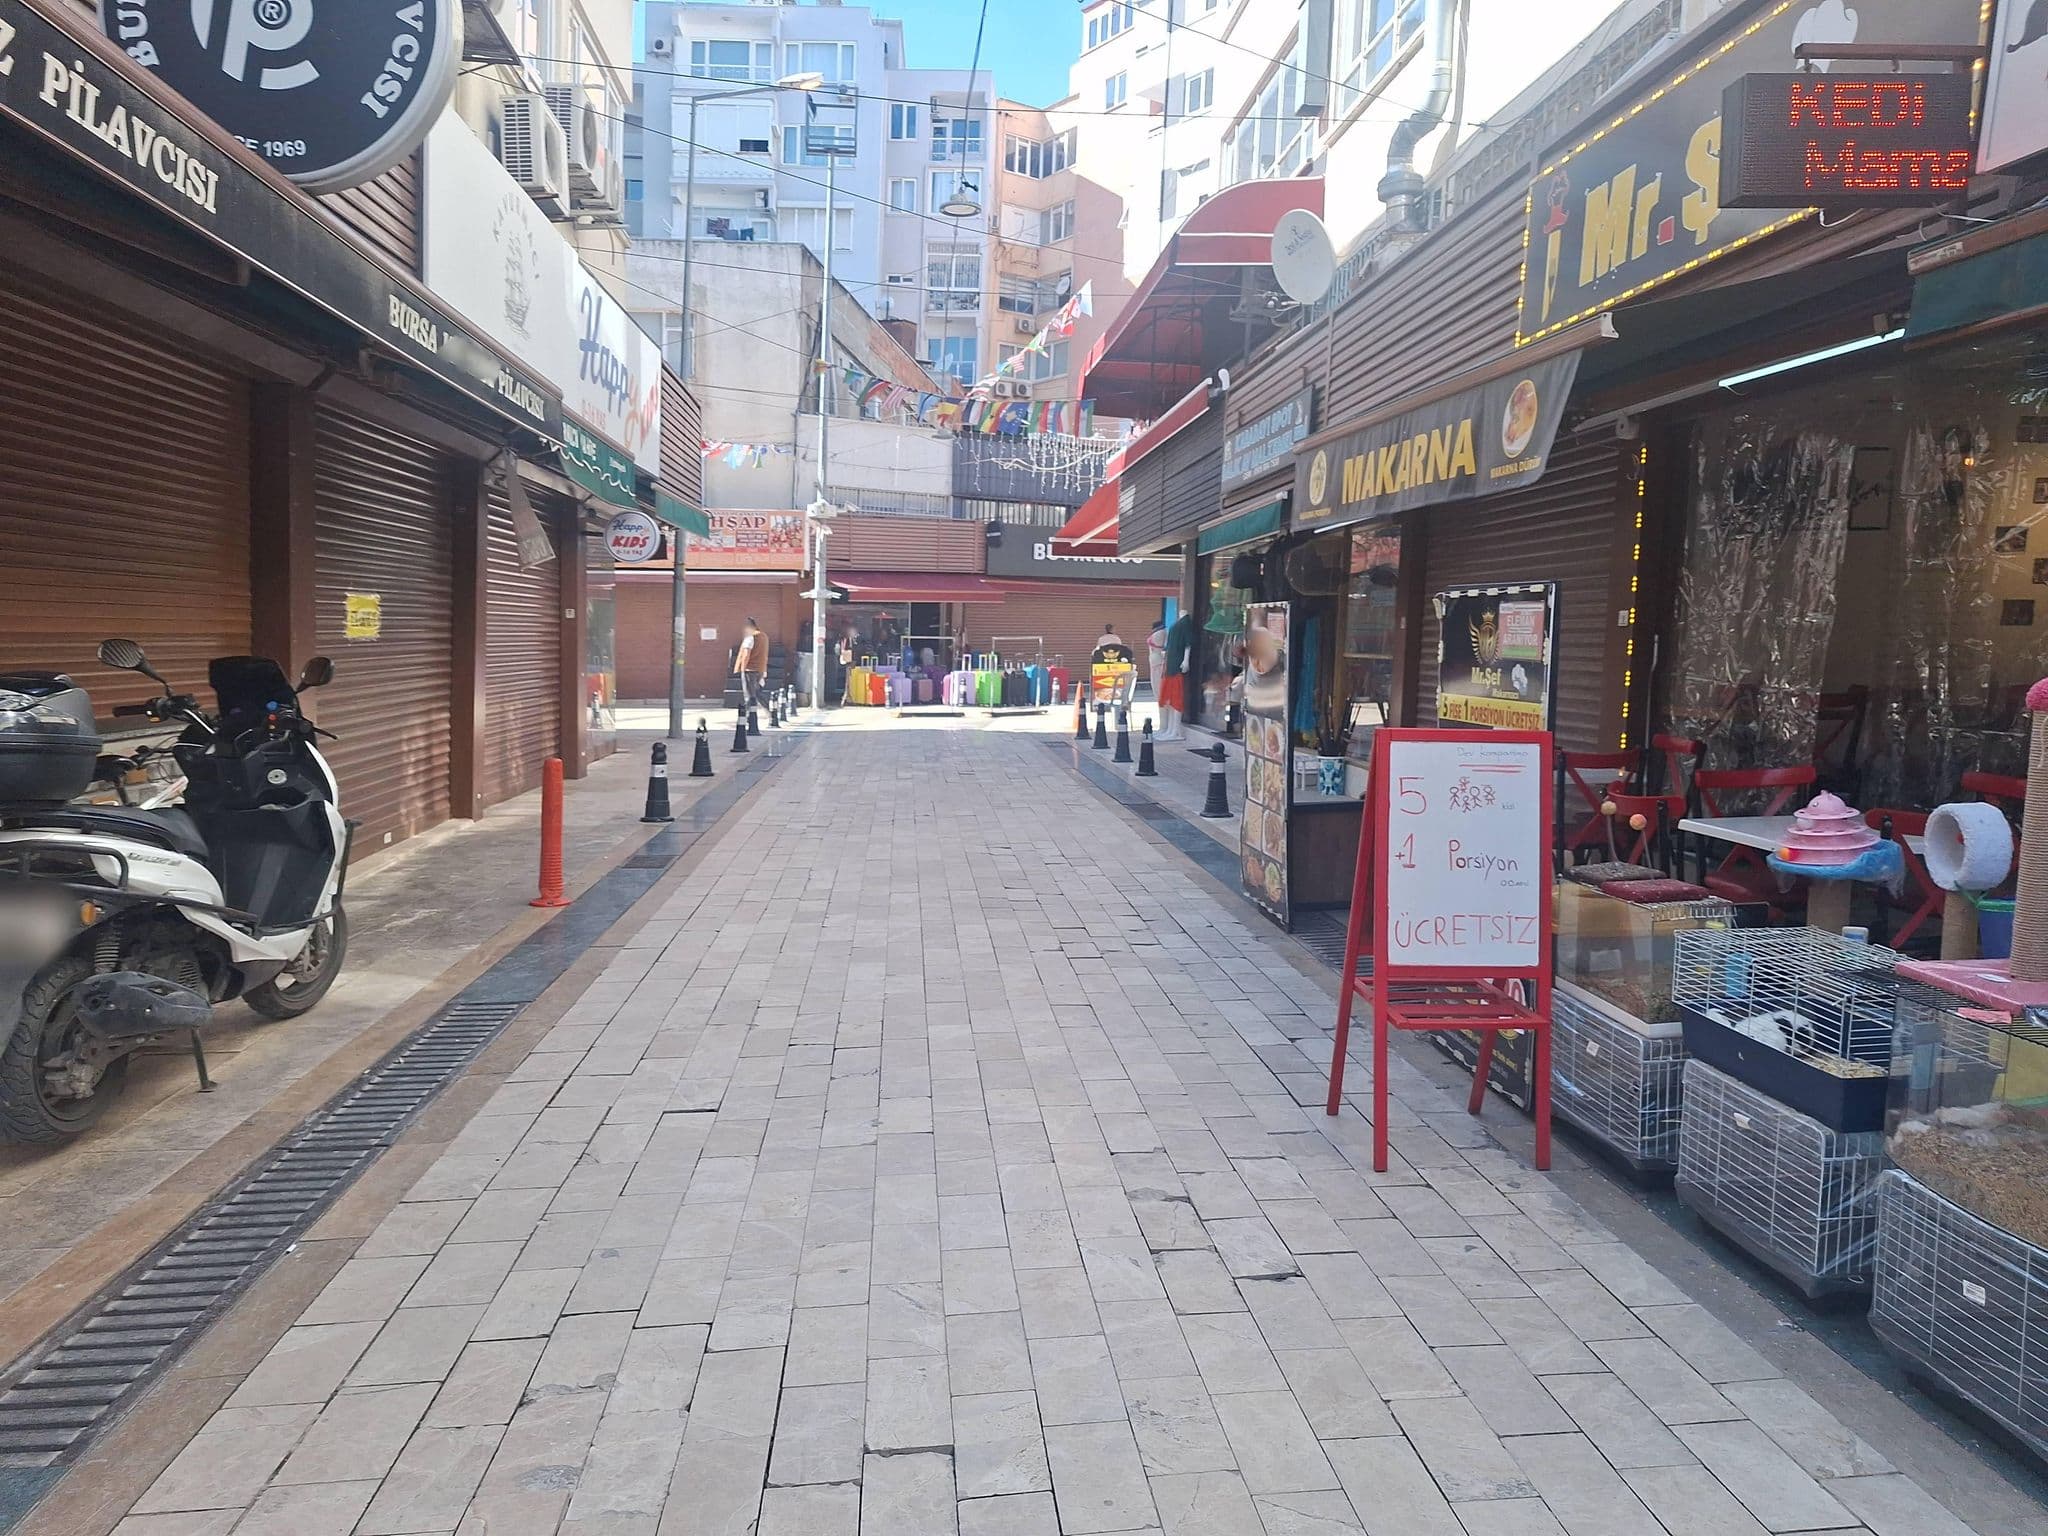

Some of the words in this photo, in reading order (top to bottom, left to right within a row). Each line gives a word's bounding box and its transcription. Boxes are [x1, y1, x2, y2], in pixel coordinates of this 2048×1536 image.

[117, 0, 160, 67] BU
[39, 52, 219, 214] PİLAVCISI
[262, 139, 307, 157] 1969
[389, 293, 438, 353] BURSA
[1341, 418, 1477, 504] MAKARNA
[1398, 776, 1427, 815] 5
[1449, 839, 1518, 881] Porsiyon
[1394, 911, 1537, 948] ÜCRETSİZ
